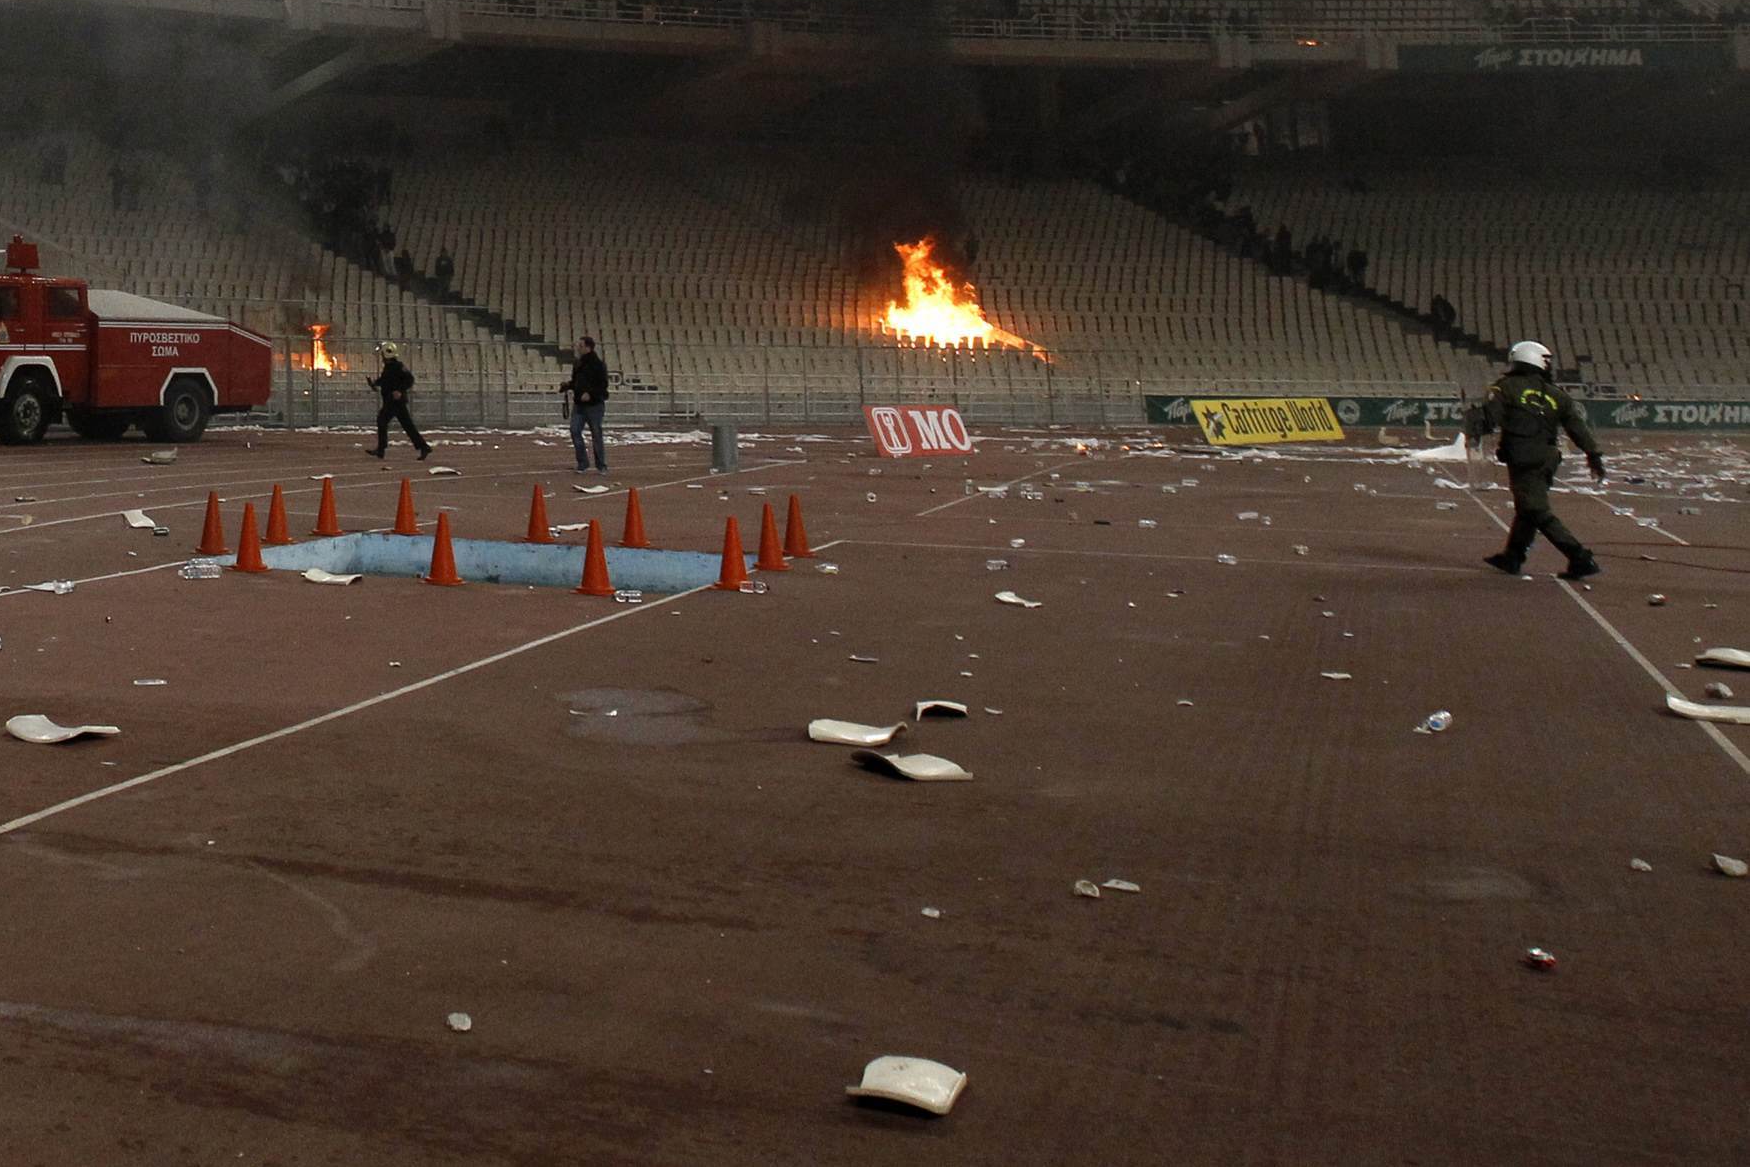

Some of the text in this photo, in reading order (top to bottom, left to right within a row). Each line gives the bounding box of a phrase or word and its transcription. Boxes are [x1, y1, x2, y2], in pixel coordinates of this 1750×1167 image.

[1518, 46, 1643, 68] ΣΤΟΙΧΗΜΑ
[130, 332, 200, 344] ΠΥΡΟΣΒΕΣΤΙΚΟ
[151, 345, 179, 357] ΣΩΜΑ
[1284, 400, 1334, 433] World
[908, 408, 972, 451] MO
